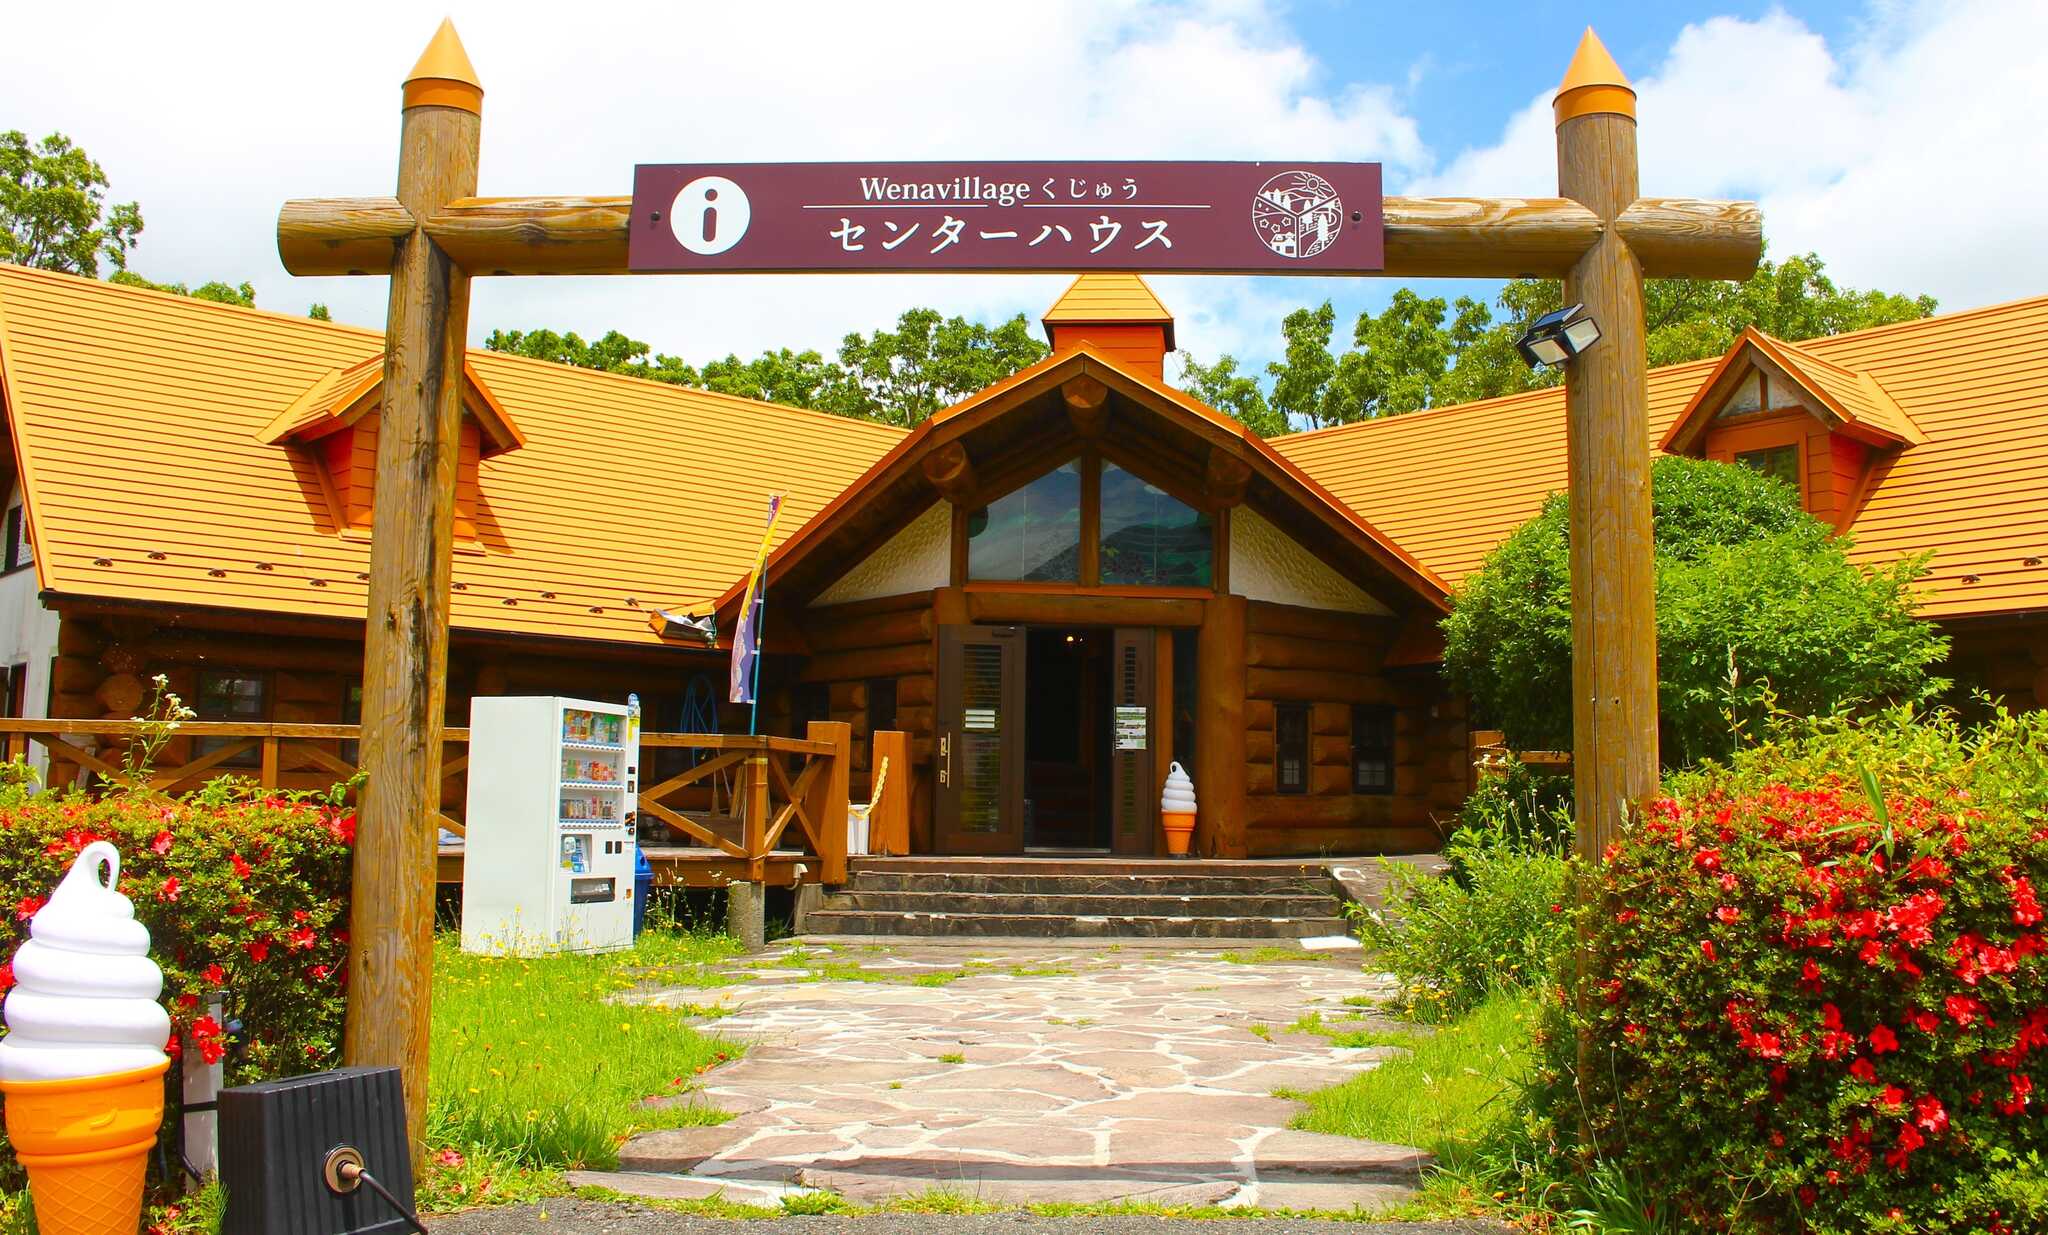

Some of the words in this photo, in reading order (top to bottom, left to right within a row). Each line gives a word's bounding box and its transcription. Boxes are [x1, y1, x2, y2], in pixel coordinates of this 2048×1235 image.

[859, 176, 1031, 207] Wenavillage
[1042, 177, 1137, 200] くじゅう
[829, 215, 1173, 254] センターハウス
